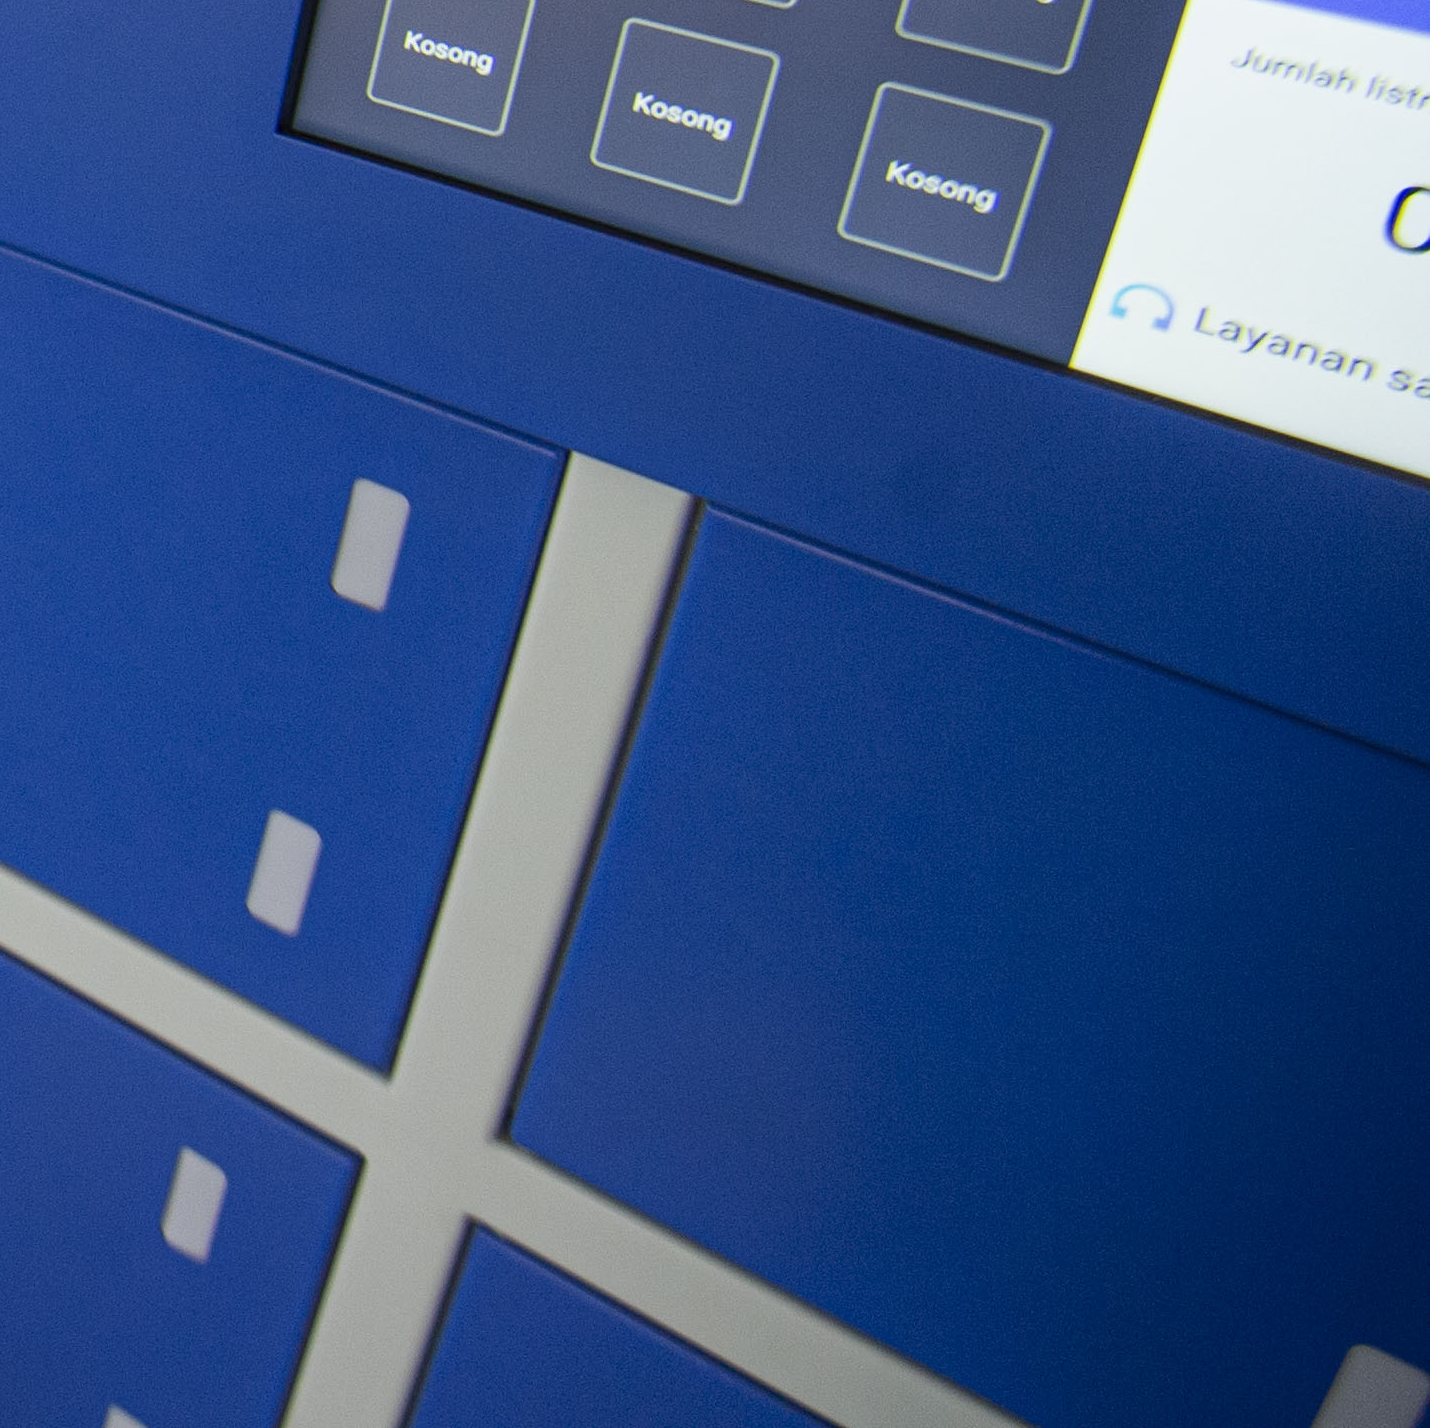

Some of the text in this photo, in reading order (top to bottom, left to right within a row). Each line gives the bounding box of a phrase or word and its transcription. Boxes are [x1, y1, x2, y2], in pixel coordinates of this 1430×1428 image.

[403, 30, 495, 76] Kosong
[1229, 46, 1359, 95] Jumlah
[632, 91, 733, 141] Kosong
[885, 160, 998, 215] Kosong
[1192, 306, 1379, 382] Layanan
